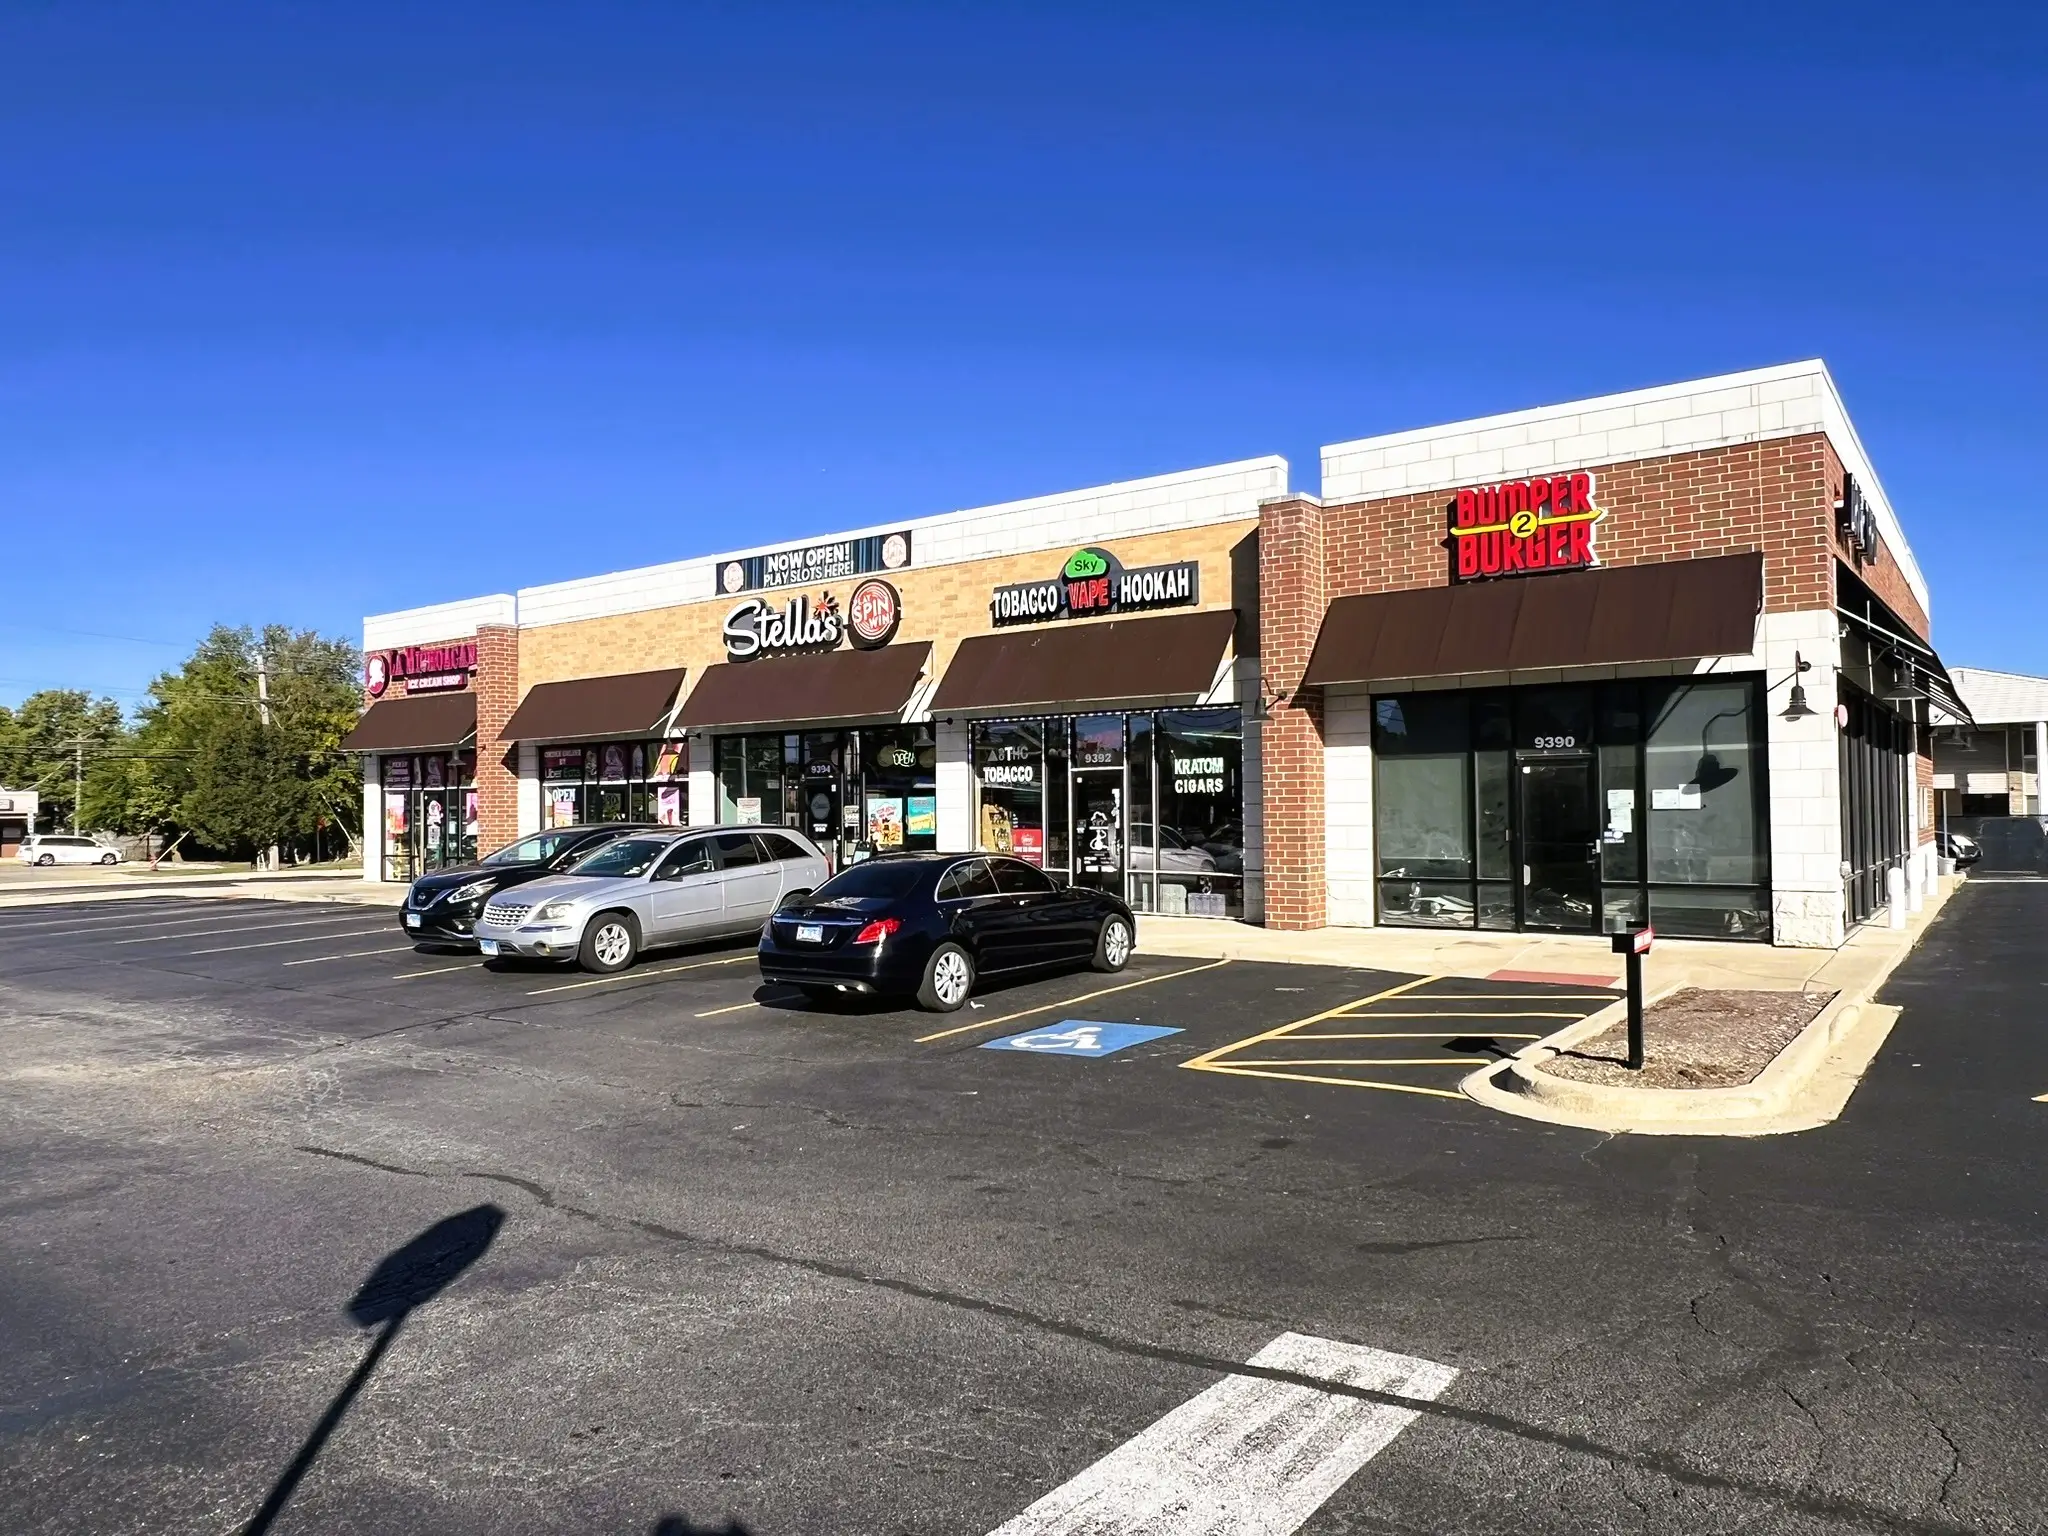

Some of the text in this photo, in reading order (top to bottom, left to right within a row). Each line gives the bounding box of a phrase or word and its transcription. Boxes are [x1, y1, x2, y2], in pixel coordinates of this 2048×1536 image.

[1457, 473, 1592, 527] BUMPER
[1516, 513, 1532, 534] 2
[1458, 519, 1592, 577] BURGER
[768, 542, 850, 573] NOW OPEN!
[1074, 559, 1098, 573] Sky
[763, 571, 788, 588] PLAY
[790, 566, 822, 584] SLOTS
[824, 560, 854, 579] HERE!
[993, 568, 1189, 618] TOBACCO VAPE HOOKAH
[852, 596, 890, 624] SPIN
[868, 612, 894, 630] WIN!
[405, 644, 477, 675] MICHOACAN
[407, 674, 461, 689] ICE CREAM SHOP
[1534, 736, 1575, 749] 9390
[1085, 753, 1112, 764] 9392
[1174, 757, 1224, 775] KRATOM
[811, 765, 831, 774] 9394
[983, 765, 1033, 783] TOBACCO
[552, 787, 576, 803] OPEN
[1174, 778, 1224, 794] CIGARS
